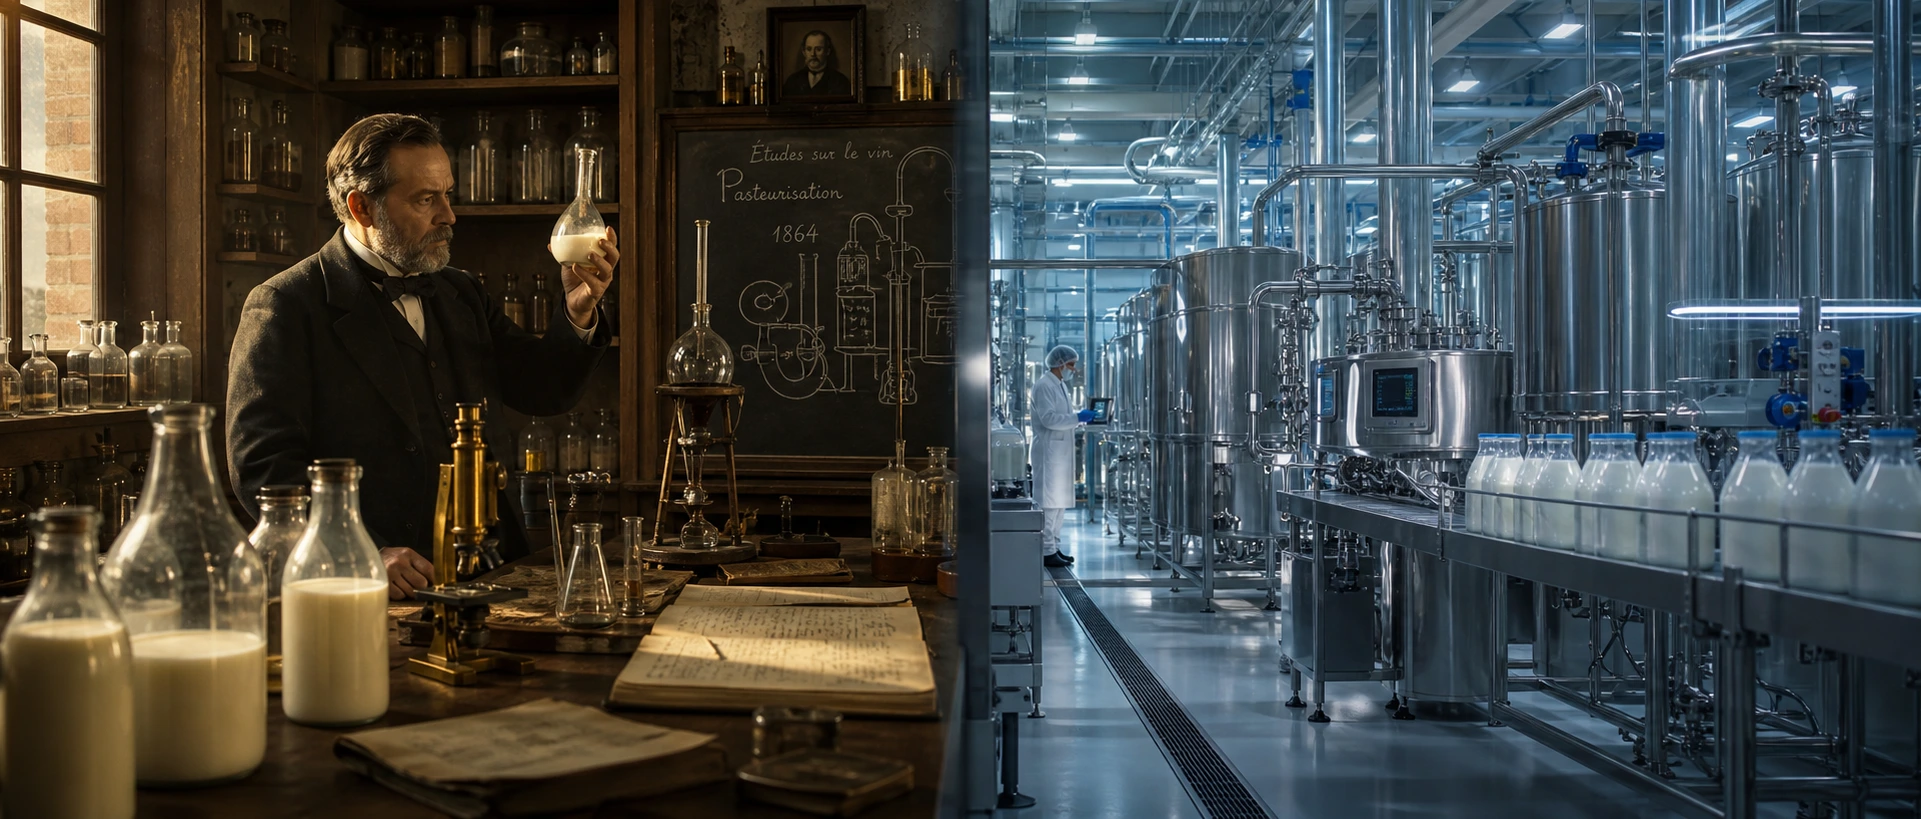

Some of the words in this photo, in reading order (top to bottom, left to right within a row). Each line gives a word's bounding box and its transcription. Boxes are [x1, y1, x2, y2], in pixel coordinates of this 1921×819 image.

[749, 139, 804, 164] Études
[811, 149, 836, 160] sur
[844, 141, 859, 160] le
[867, 145, 894, 159] vin
[716, 167, 844, 202] Pasteurisation
[771, 223, 819, 243] 1864
